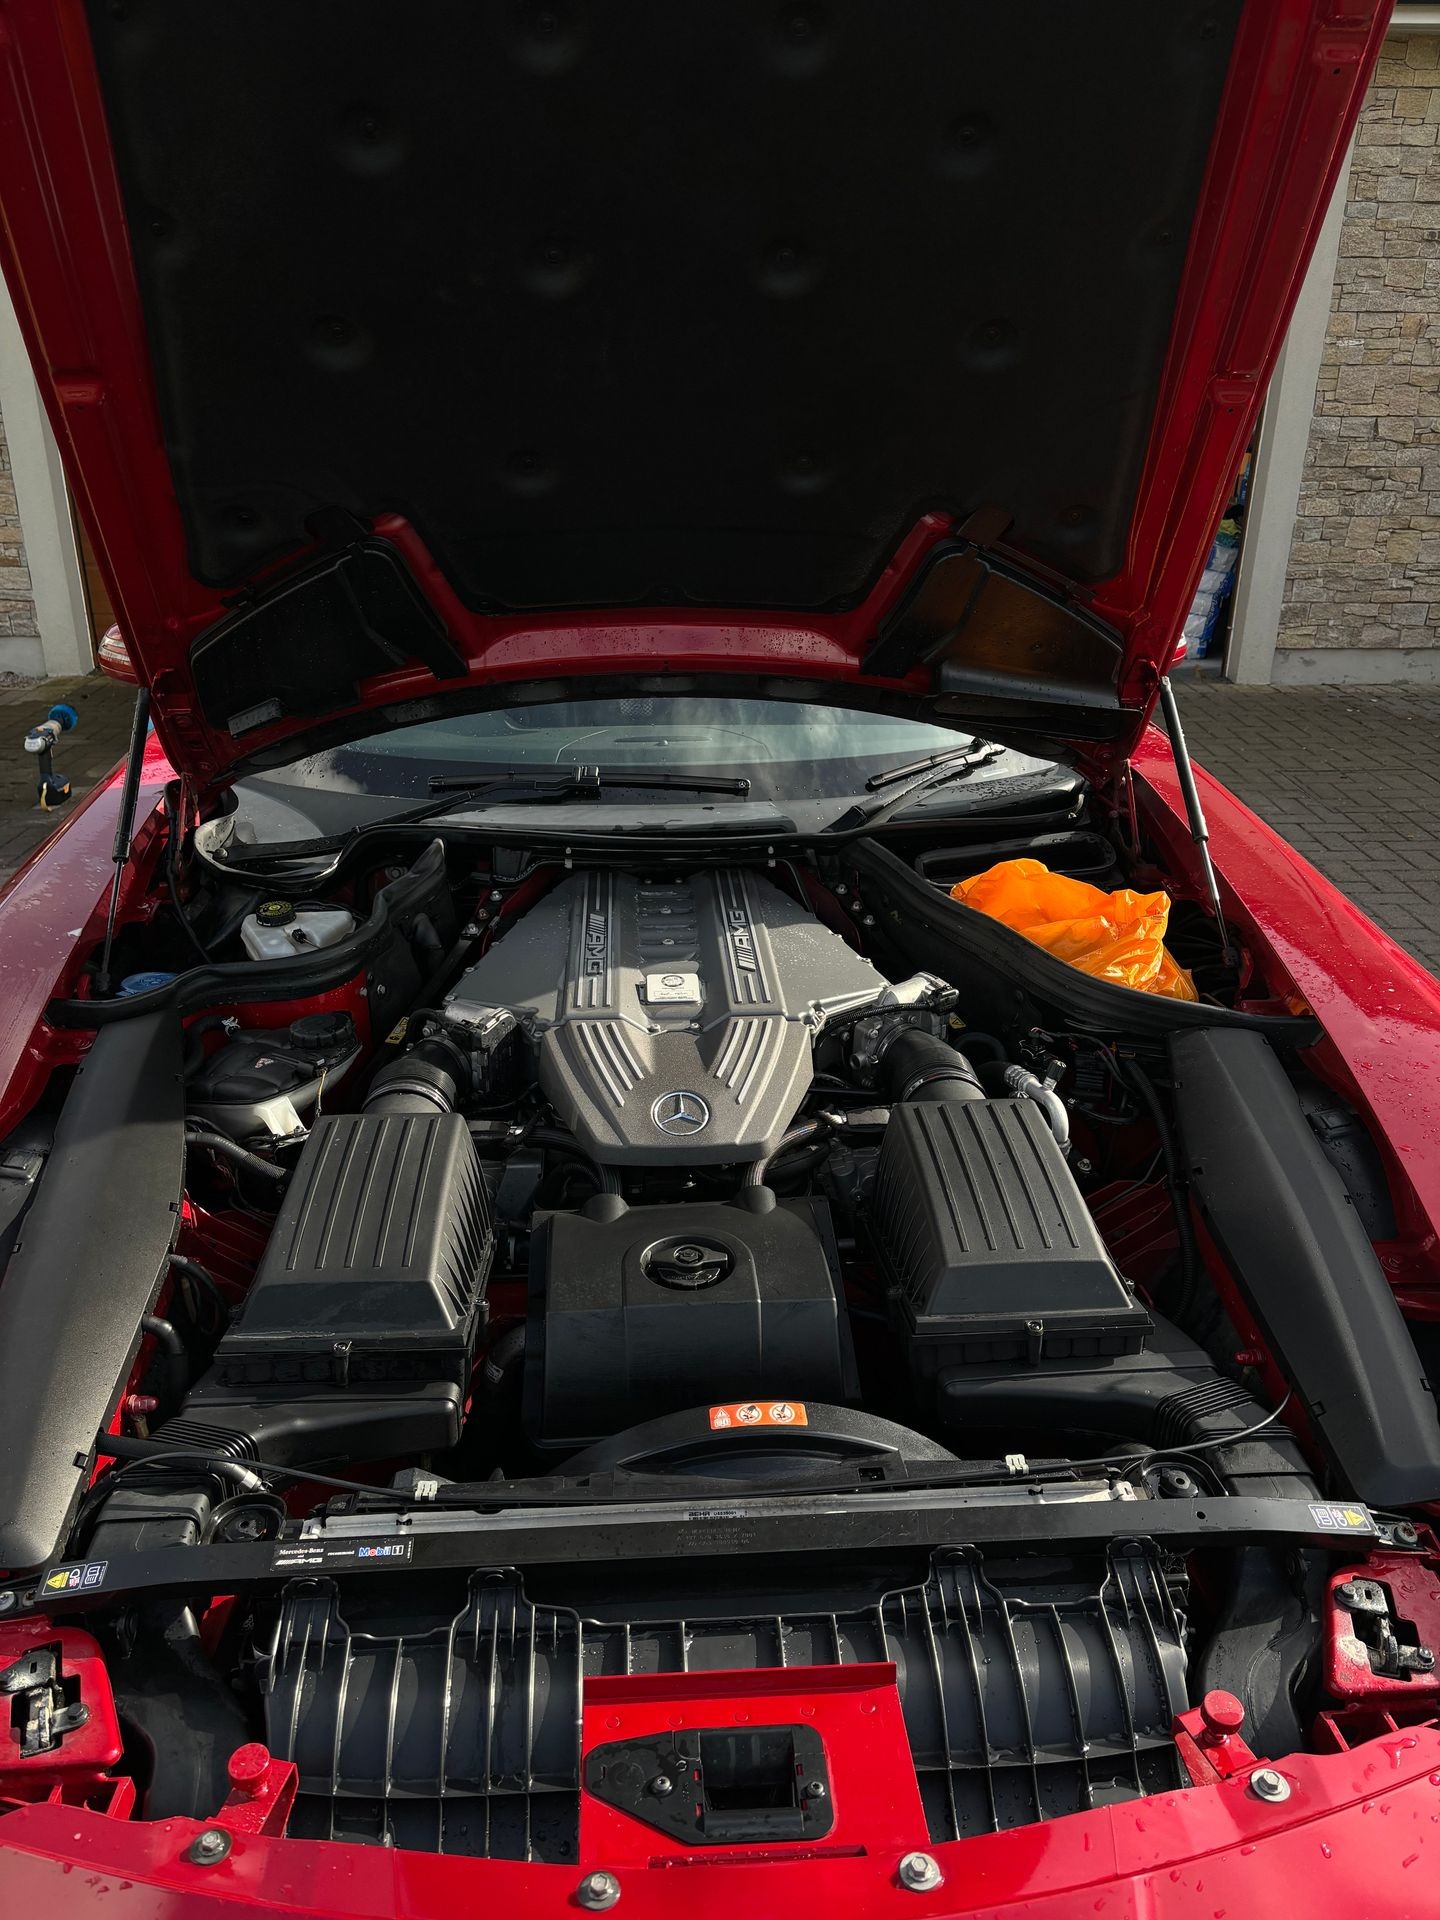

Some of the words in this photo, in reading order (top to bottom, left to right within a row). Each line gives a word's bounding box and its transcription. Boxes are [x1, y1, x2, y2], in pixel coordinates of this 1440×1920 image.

[729, 910, 752, 949] AMG
[586, 932, 606, 974] AMG
[279, 1547, 324, 1556] Mercedes-Benz
[358, 1545, 392, 1558] Mobil
